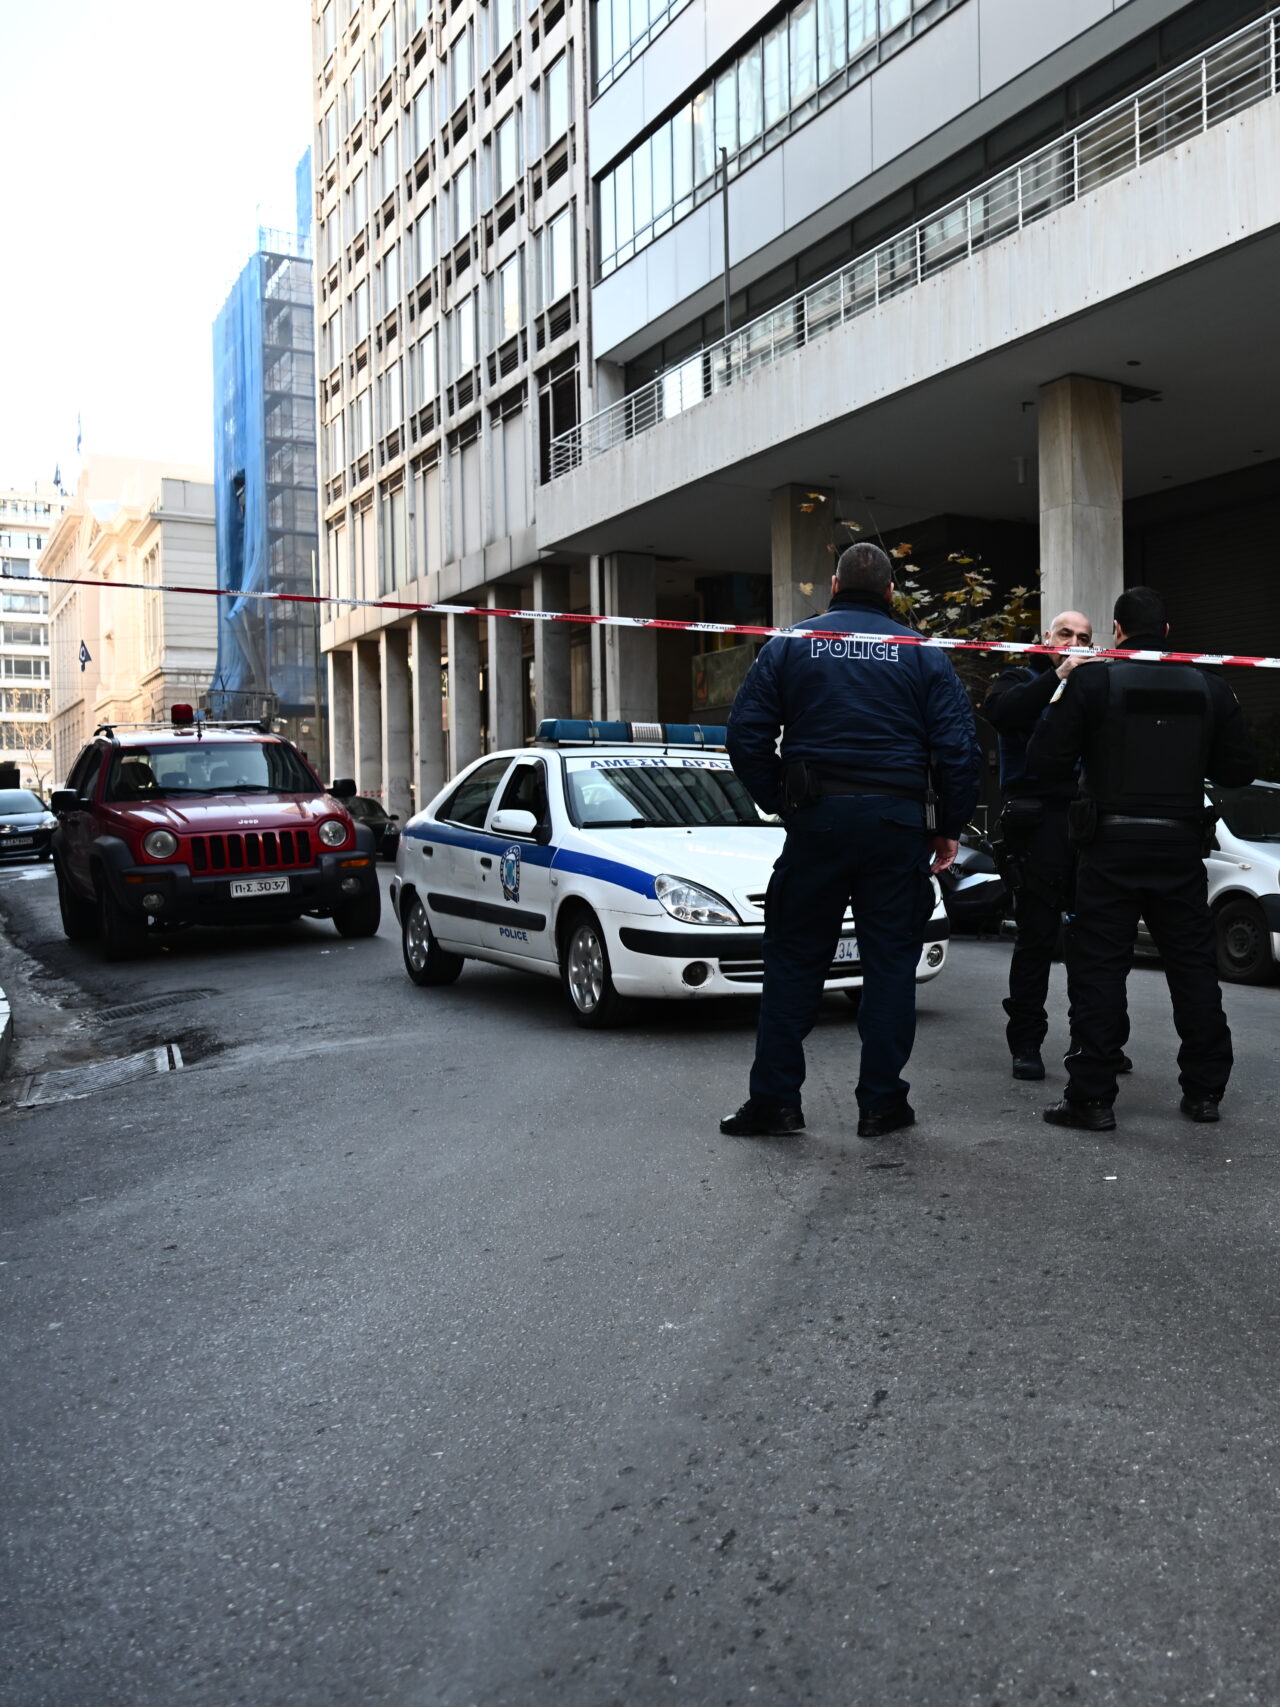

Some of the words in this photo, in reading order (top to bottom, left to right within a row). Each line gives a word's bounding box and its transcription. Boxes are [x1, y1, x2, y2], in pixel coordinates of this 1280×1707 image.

[810, 637, 899, 662] POLICE
[590, 758, 668, 769] ΑΜΕΣΗ
[681, 759, 734, 770] ΔΡΑΣ
[499, 926, 529, 942] POLICE
